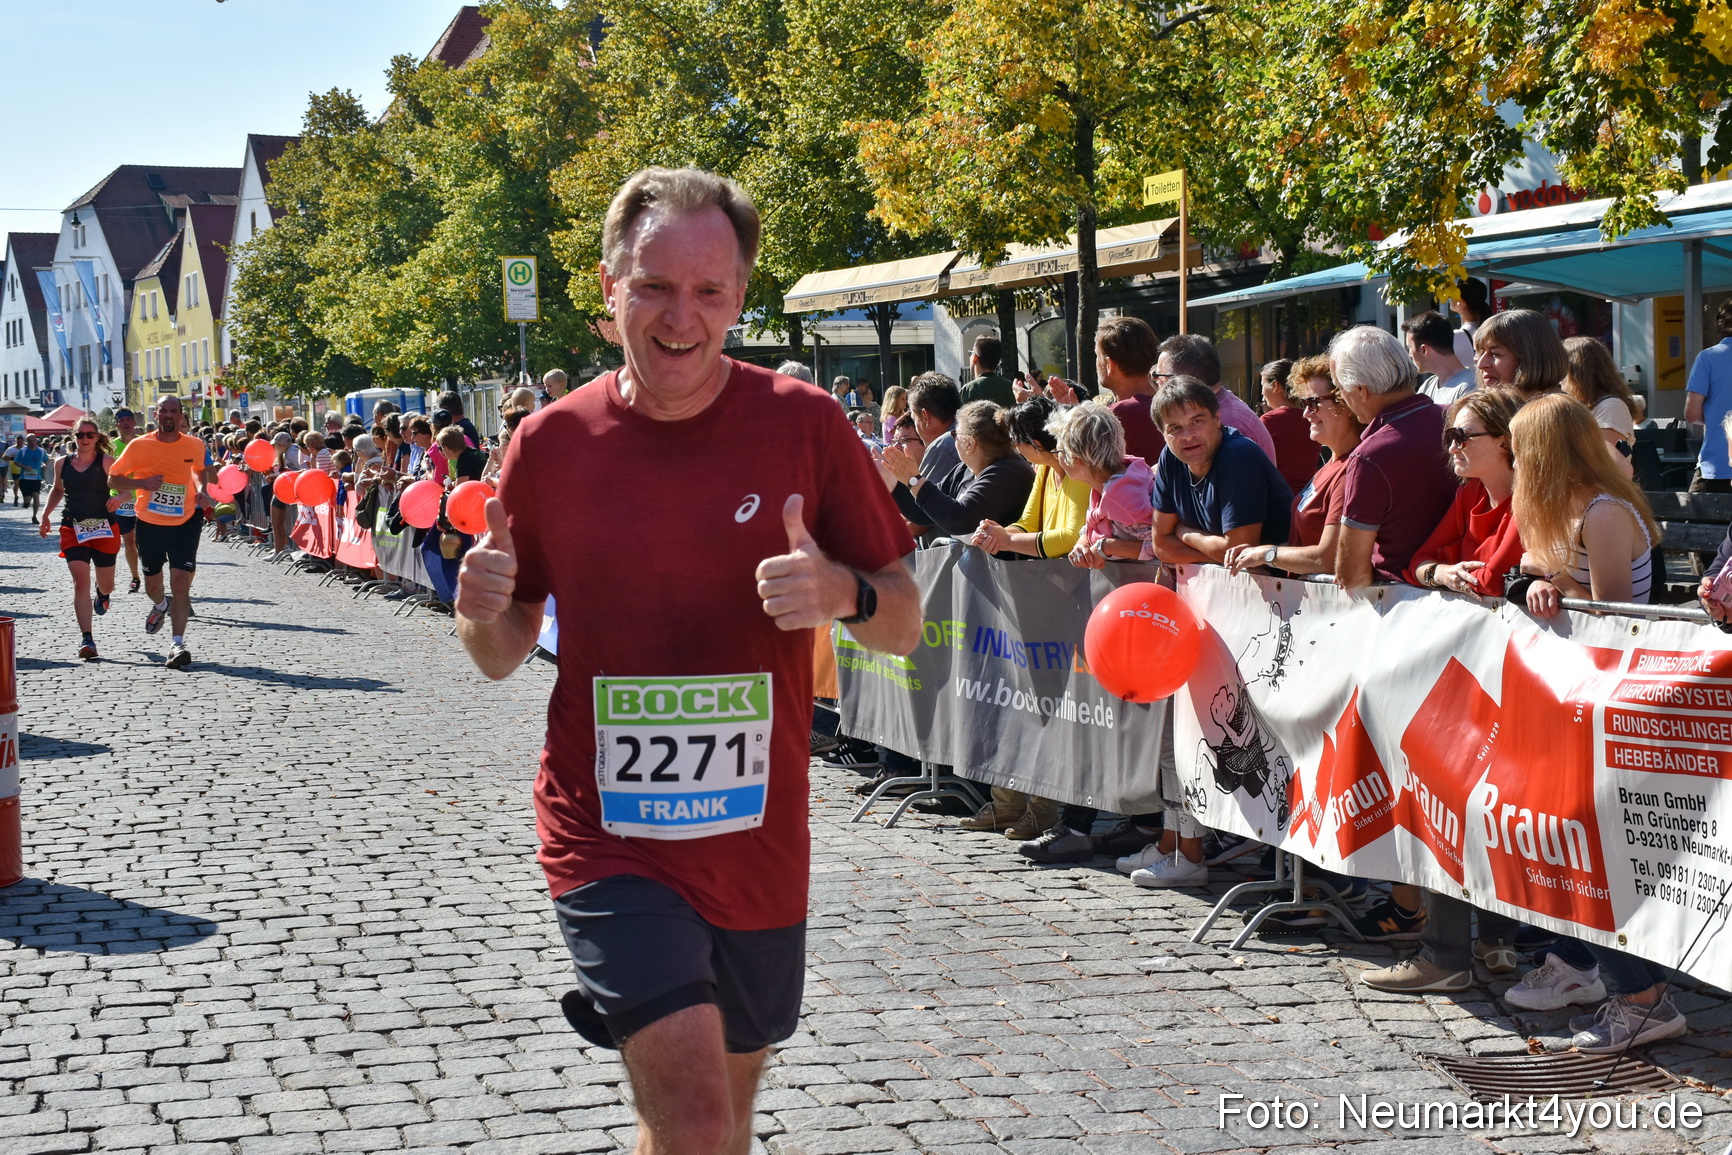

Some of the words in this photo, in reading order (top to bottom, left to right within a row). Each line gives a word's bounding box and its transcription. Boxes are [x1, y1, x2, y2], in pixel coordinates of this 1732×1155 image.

[1151, 181, 1180, 196] Toiletten
[1507, 179, 1589, 212] vodafo
[154, 492, 181, 506] 2532
[1151, 620, 1179, 637] energie
[1637, 654, 1714, 673] BINDESTRICKE
[609, 681, 758, 719] BOCK
[755, 734, 763, 742] D
[1477, 744, 1490, 761] Seit
[1487, 722, 1500, 745] 1929
[1612, 714, 1732, 741] RUNDSCHLINGE
[615, 732, 746, 782] 2271
[1614, 747, 1720, 774] HEBEBÄNDER
[638, 796, 728, 821] FRANK
[1331, 771, 1389, 834] Braun
[1401, 752, 1459, 848] Braun
[1619, 787, 1660, 807] Braun
[1664, 791, 1707, 812] GmbH
[1353, 811, 1376, 831] Sicher
[1375, 804, 1384, 818] ist
[1478, 780, 1592, 874] Braun
[1624, 808, 1644, 826] Am
[1648, 810, 1708, 839] Grünberg
[1711, 819, 1717, 837] 8
[1436, 835, 1445, 852] ist
[1445, 846, 1465, 868] sicher
[1626, 829, 1679, 851] D-92318
[1525, 866, 1557, 889] Sicher
[1560, 874, 1575, 892] ist
[1577, 880, 1610, 900] sicher
[1630, 858, 1655, 877] Tel.
[1657, 862, 1689, 885] 09181
[1698, 872, 1726, 897] 2307-0
[1635, 879, 1657, 898] Fax
[1660, 883, 1688, 907] 09181
